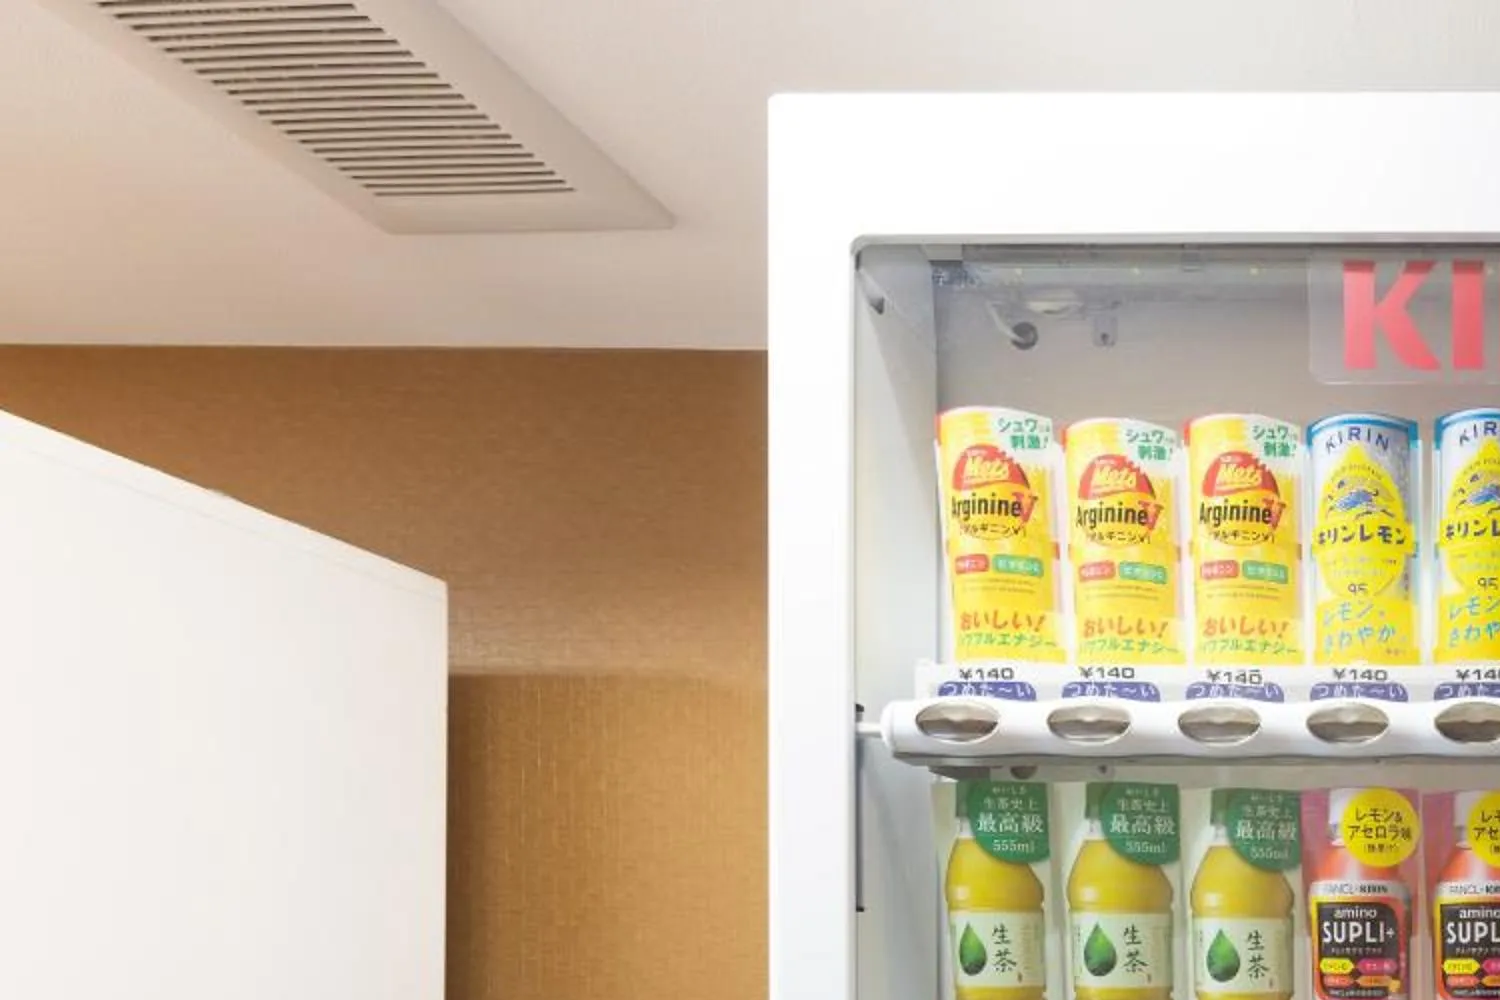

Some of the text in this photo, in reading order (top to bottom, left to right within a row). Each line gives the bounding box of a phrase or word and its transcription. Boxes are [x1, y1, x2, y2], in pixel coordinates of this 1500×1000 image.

[1326, 425, 1390, 451] KIRIN
[952, 494, 1021, 521] Arginine
[1076, 501, 1149, 528] Arginine
[1199, 499, 1273, 526] Arginine
[1317, 525, 1406, 546] キリンレモン
[960, 667, 1015, 681] ¥140
[1079, 666, 1136, 680] ¥140
[1206, 668, 1264, 685] ¥140
[1333, 668, 1388, 682] ¥140
[977, 813, 1045, 835] 最高級
[1110, 813, 1176, 836] 最高級
[1236, 818, 1296, 841] 最高級
[1334, 906, 1377, 918] amino
[1323, 921, 1396, 943] SUPLI+
[991, 924, 1017, 973] 生茶
[1123, 924, 1150, 974] 生茶
[1247, 929, 1270, 980] 生茶
